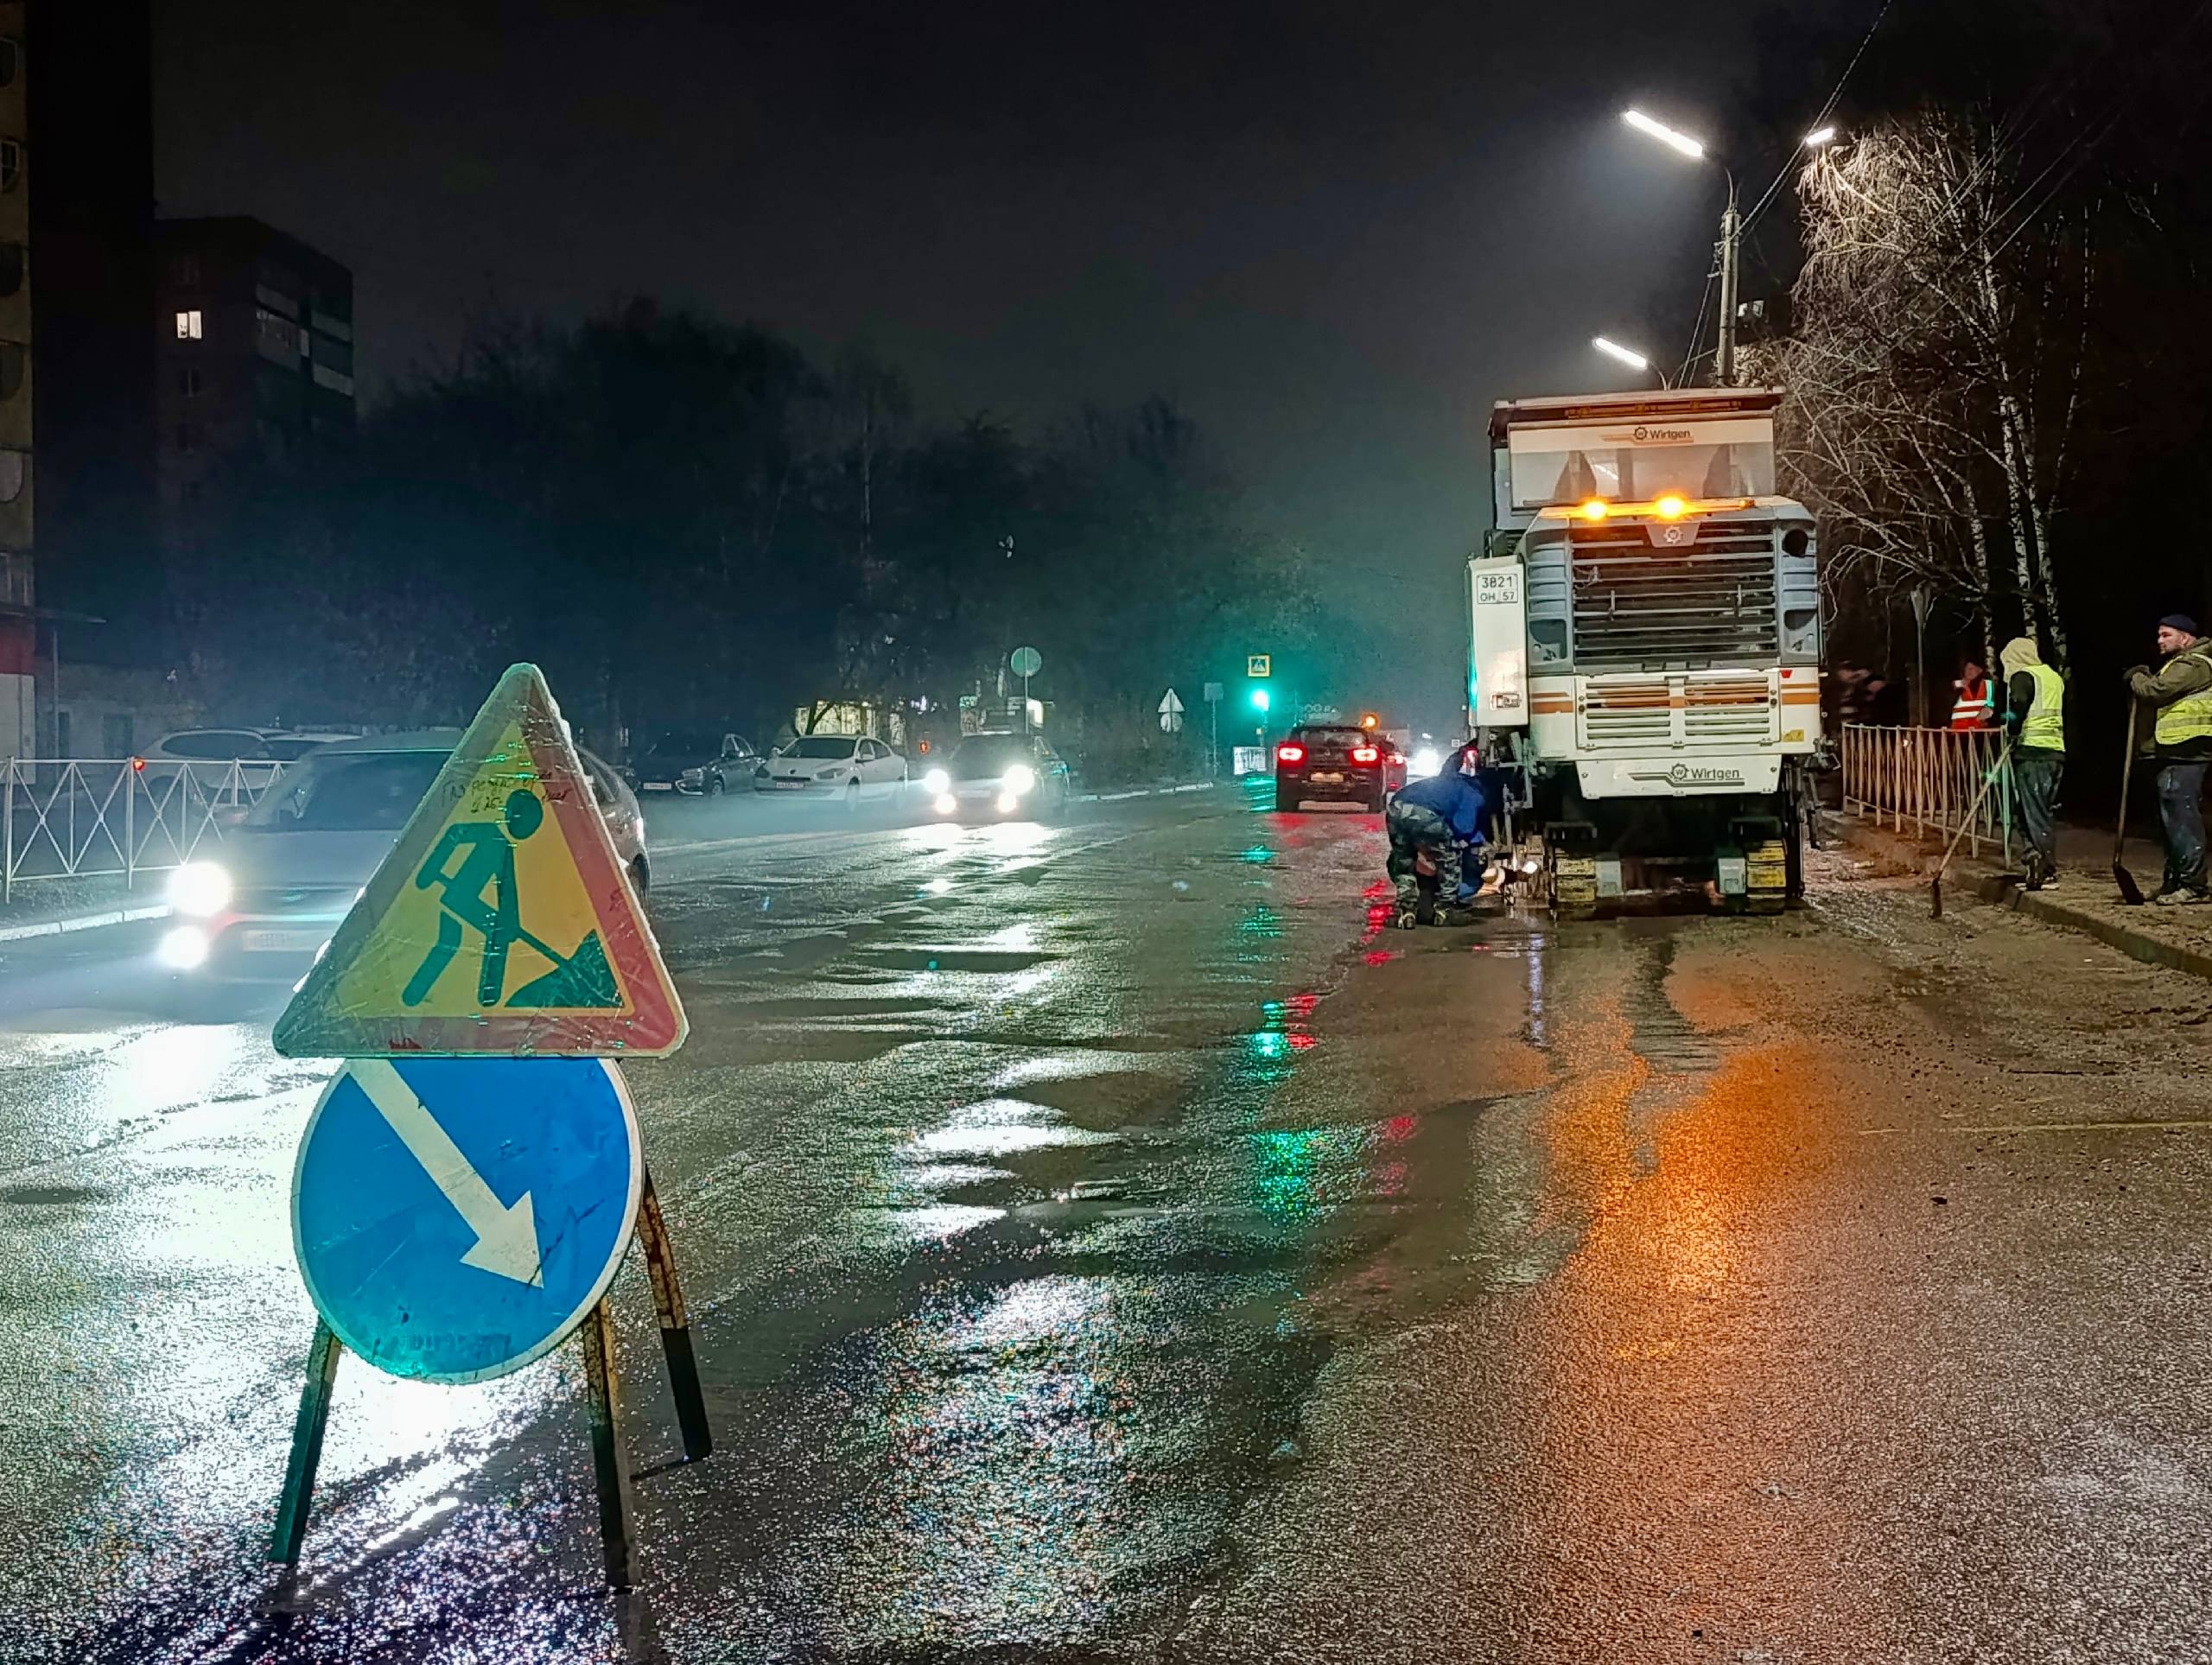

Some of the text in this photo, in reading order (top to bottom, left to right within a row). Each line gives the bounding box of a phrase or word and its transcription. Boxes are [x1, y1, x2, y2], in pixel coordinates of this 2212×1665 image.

[1649, 429, 1691, 440] Wirtgen
[1481, 575, 1513, 588] 3821
[1502, 591, 1515, 601] 57
[1691, 767, 1740, 780] Wirtgen
